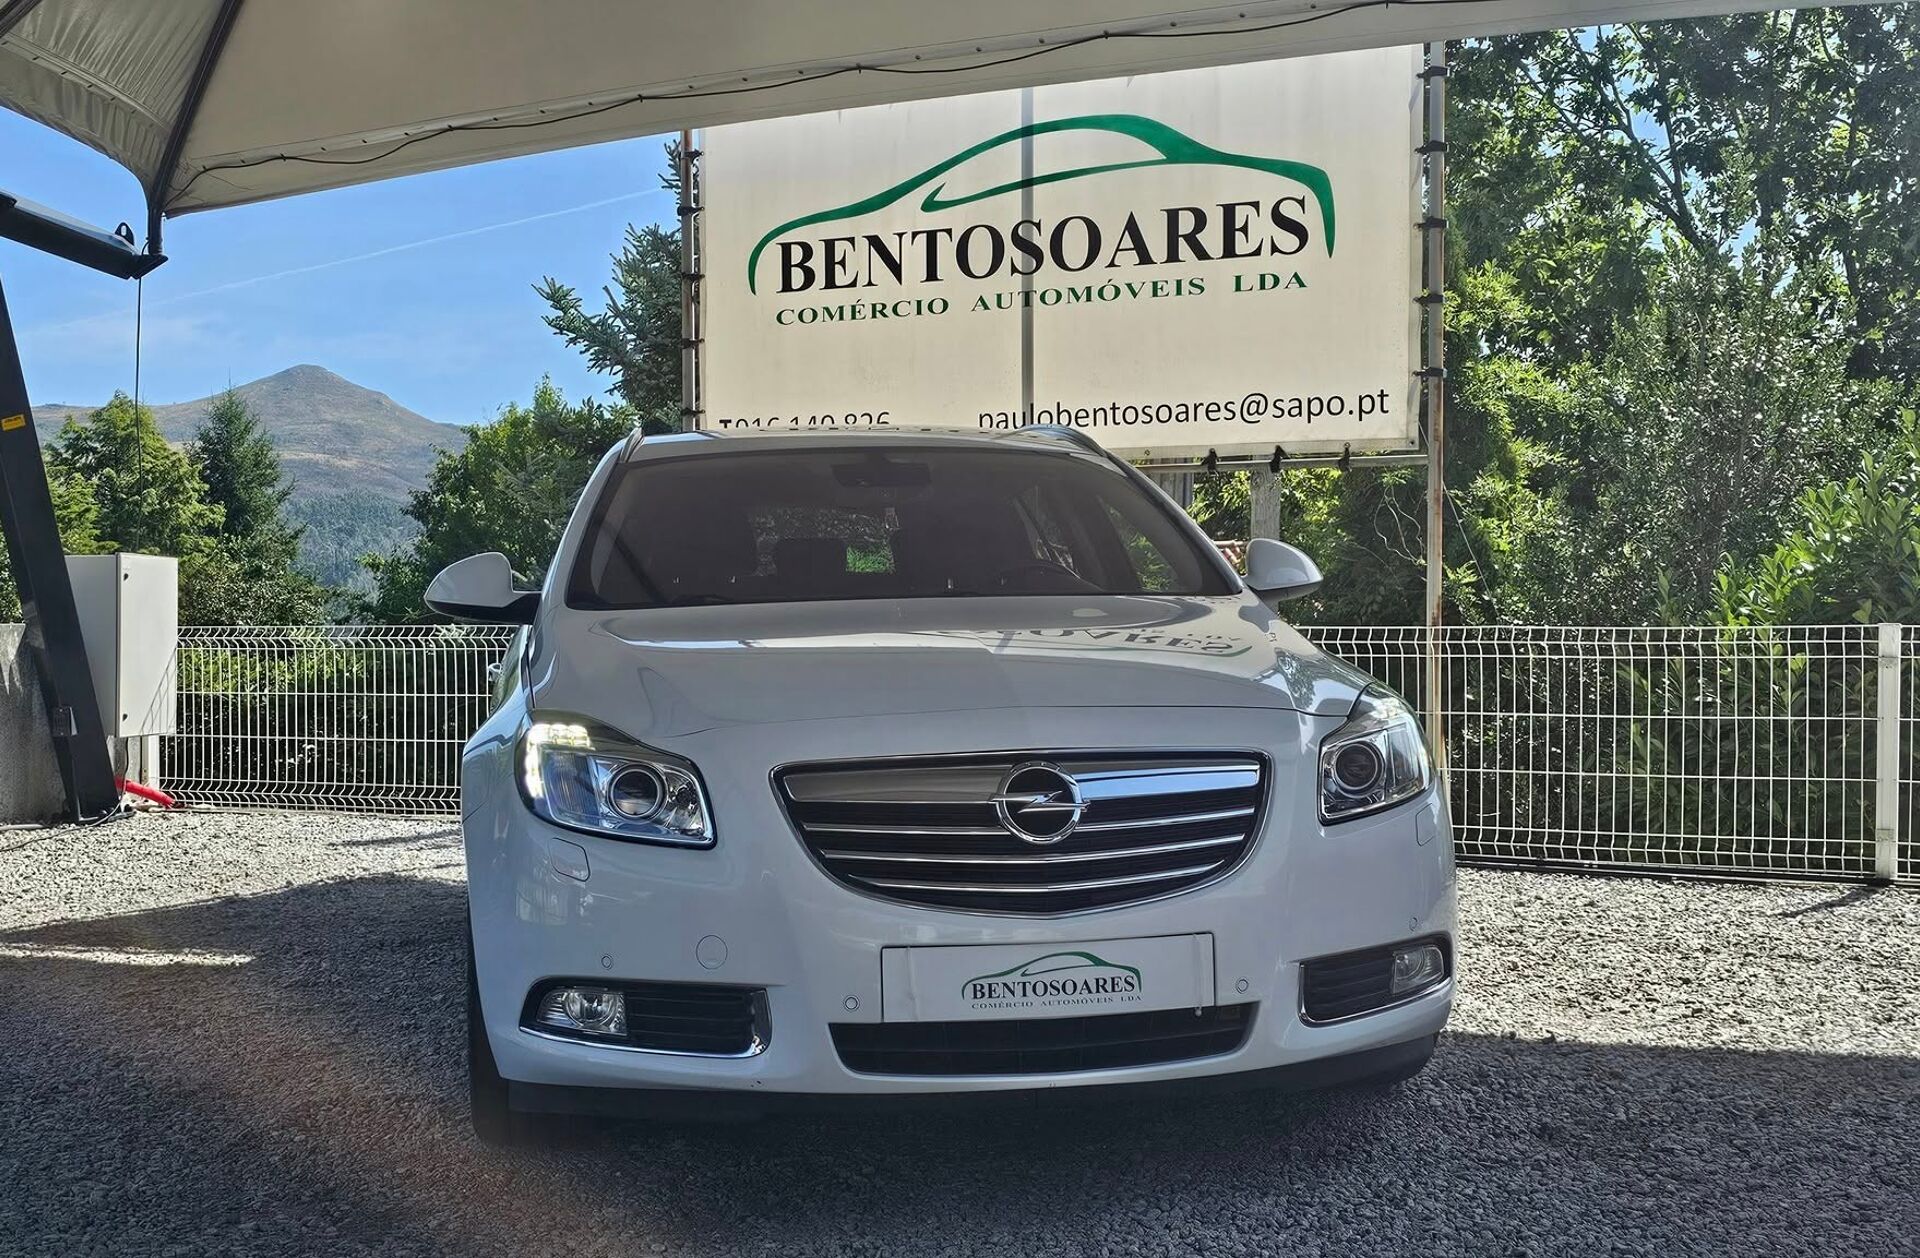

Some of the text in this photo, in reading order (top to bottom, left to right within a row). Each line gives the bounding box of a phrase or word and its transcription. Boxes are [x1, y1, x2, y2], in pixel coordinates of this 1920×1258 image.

[775, 195, 1309, 294] BENTOSOARES
[776, 271, 1308, 326] COMÉRCIO AUTOMÓVEIS LDA
[971, 975, 1136, 1000] BENTOSOARES
[971, 1001, 1034, 1009] COMÉRCIO
[1040, 996, 1114, 1007] AUTOMÓVEIS
